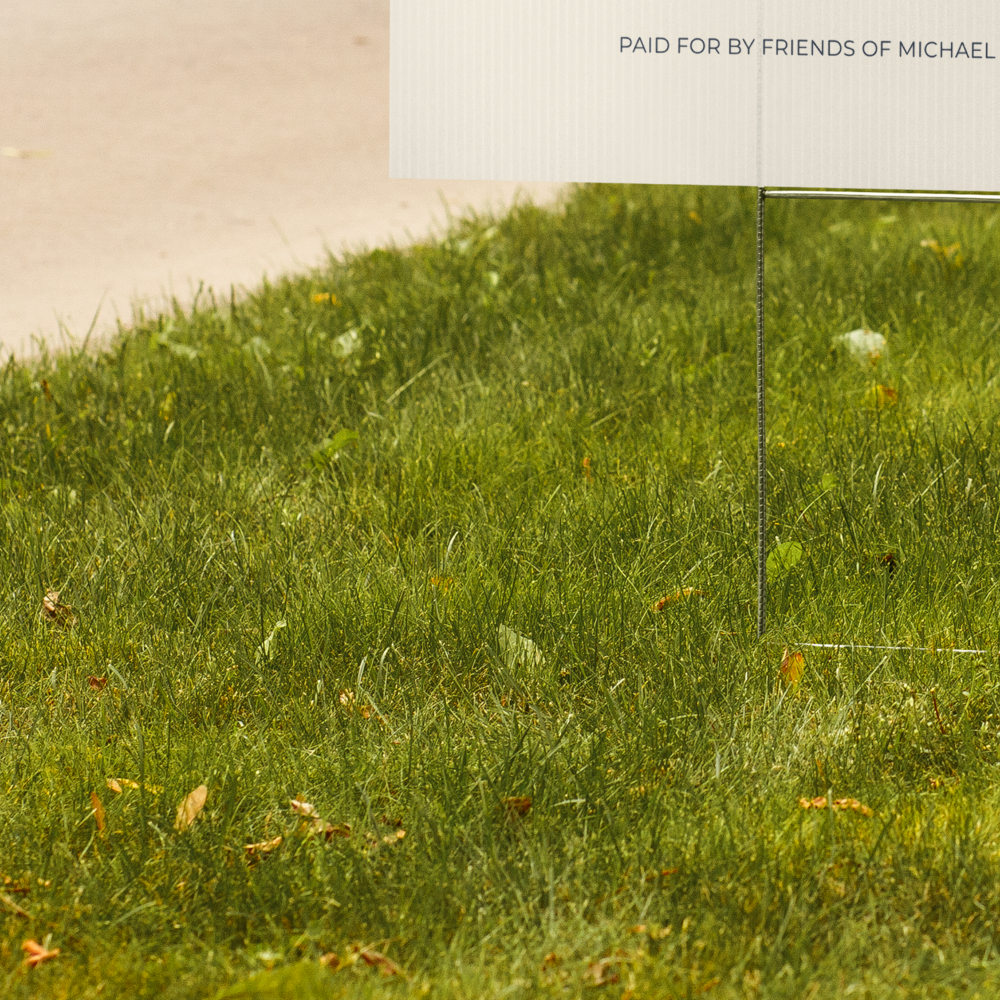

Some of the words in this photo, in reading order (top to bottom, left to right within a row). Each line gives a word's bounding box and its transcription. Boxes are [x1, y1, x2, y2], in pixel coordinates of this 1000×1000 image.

[620, 36, 670, 54] PAID
[677, 37, 721, 55] FOR
[728, 37, 756, 55] BY
[762, 38, 856, 57] FRIENDS
[861, 40, 892, 58] OF
[899, 40, 996, 59] MICHAEL
